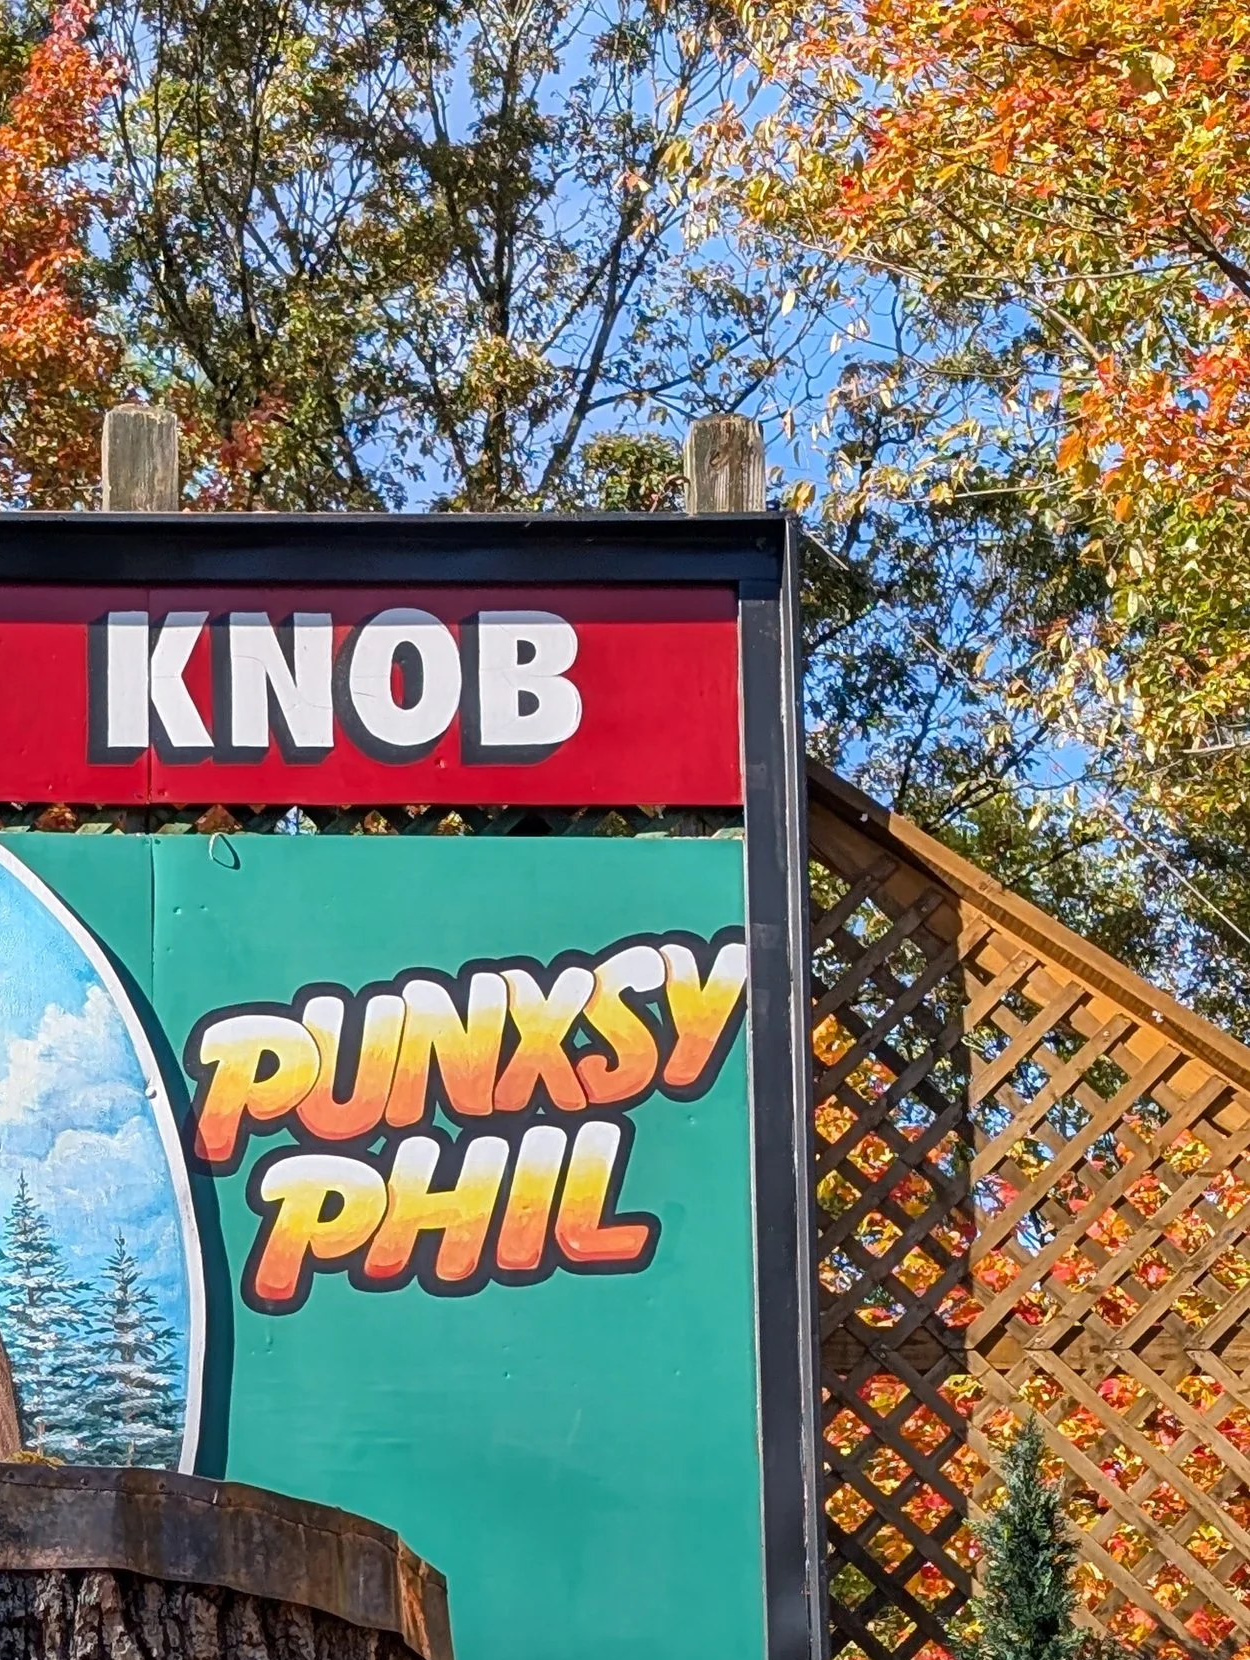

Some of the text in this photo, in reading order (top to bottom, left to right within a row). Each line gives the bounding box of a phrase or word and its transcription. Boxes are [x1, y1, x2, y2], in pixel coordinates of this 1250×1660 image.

[103, 608, 582, 748] KNOB
[194, 942, 747, 1163] PUNXSY
[253, 1120, 650, 1300] PHIL
